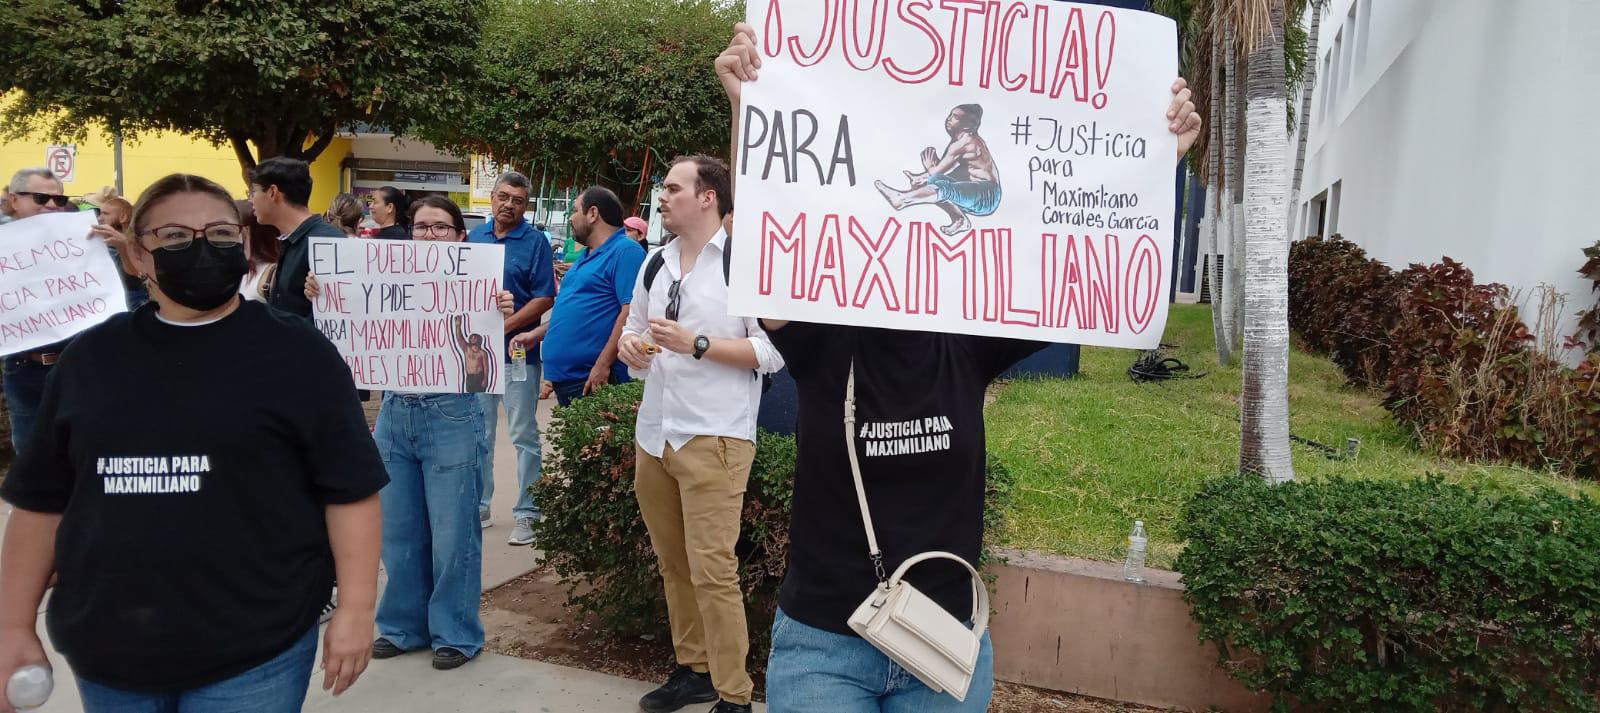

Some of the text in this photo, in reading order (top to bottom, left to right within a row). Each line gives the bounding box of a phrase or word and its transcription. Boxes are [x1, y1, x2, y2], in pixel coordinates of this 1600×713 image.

[740, 104, 856, 186] PARA
[1028, 156, 1073, 191] para
[1043, 180, 1138, 209] Maximiliano
[1042, 206, 1104, 229] Corrales
[313, 242, 471, 275] EL PUEBLO SE
[757, 211, 1162, 335] MAXIMILIANO
[45, 271, 101, 297] PARA
[315, 277, 501, 314] UNE Y PIDE JUSTICIA
[315, 318, 446, 352] PARA MAXIMILIANO
[860, 419, 923, 439] #JUSTICIA
[866, 433, 950, 457] MAXIMILIANO
[97, 455, 210, 474] #JUSTICIA PARA
[104, 475, 201, 494] MAXIMILIANO
